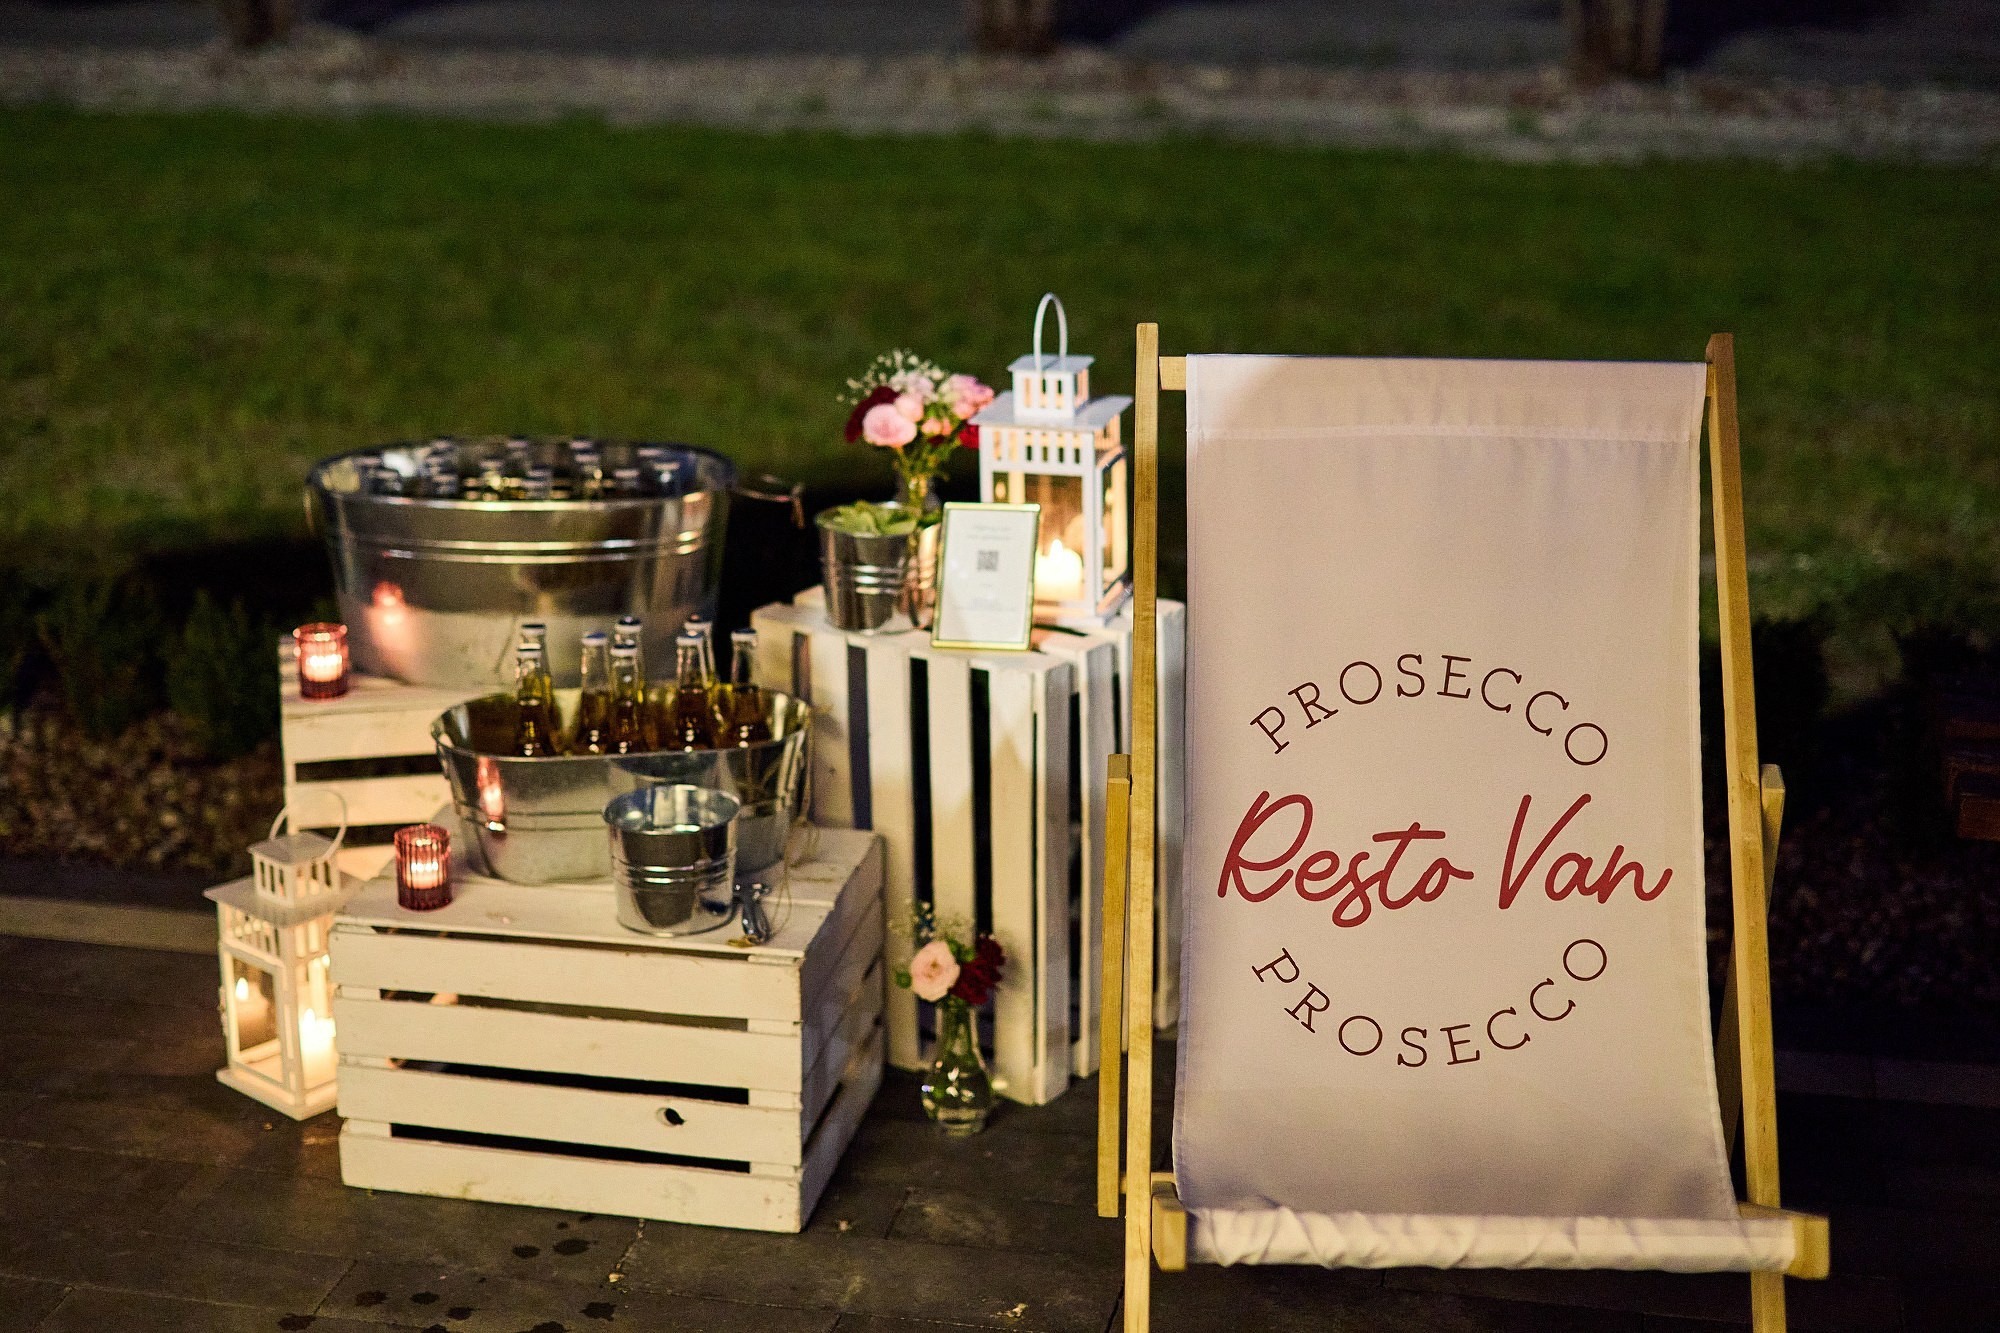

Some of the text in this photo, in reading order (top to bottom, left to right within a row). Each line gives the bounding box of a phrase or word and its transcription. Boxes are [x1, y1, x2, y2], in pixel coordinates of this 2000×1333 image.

[1250, 653, 1608, 766] PROSECCO
[1217, 790, 1673, 928] Resto Van
[1251, 938, 1608, 1068] PROSECCO
